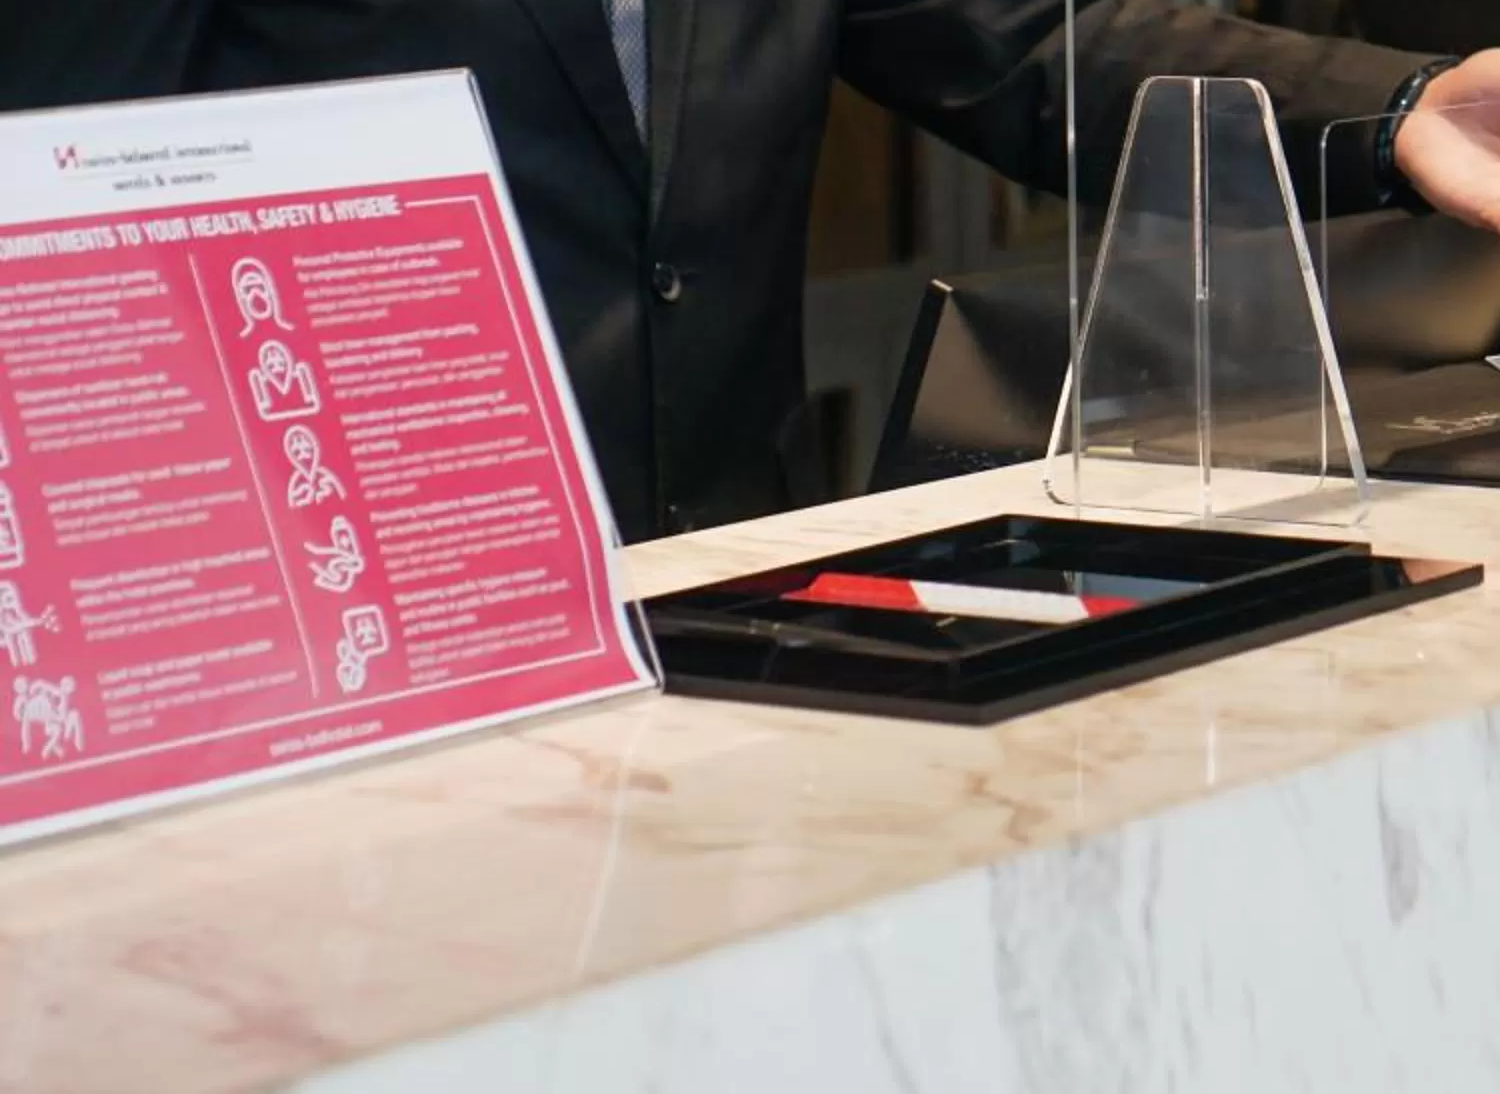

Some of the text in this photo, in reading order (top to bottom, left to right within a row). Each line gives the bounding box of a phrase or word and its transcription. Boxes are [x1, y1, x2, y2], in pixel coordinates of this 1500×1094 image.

[116, 222, 144, 247] TO
[142, 217, 190, 244] YOUR
[256, 203, 316, 229] SAFETY
[319, 201, 334, 224] &
[333, 194, 402, 221] HYGIENE
